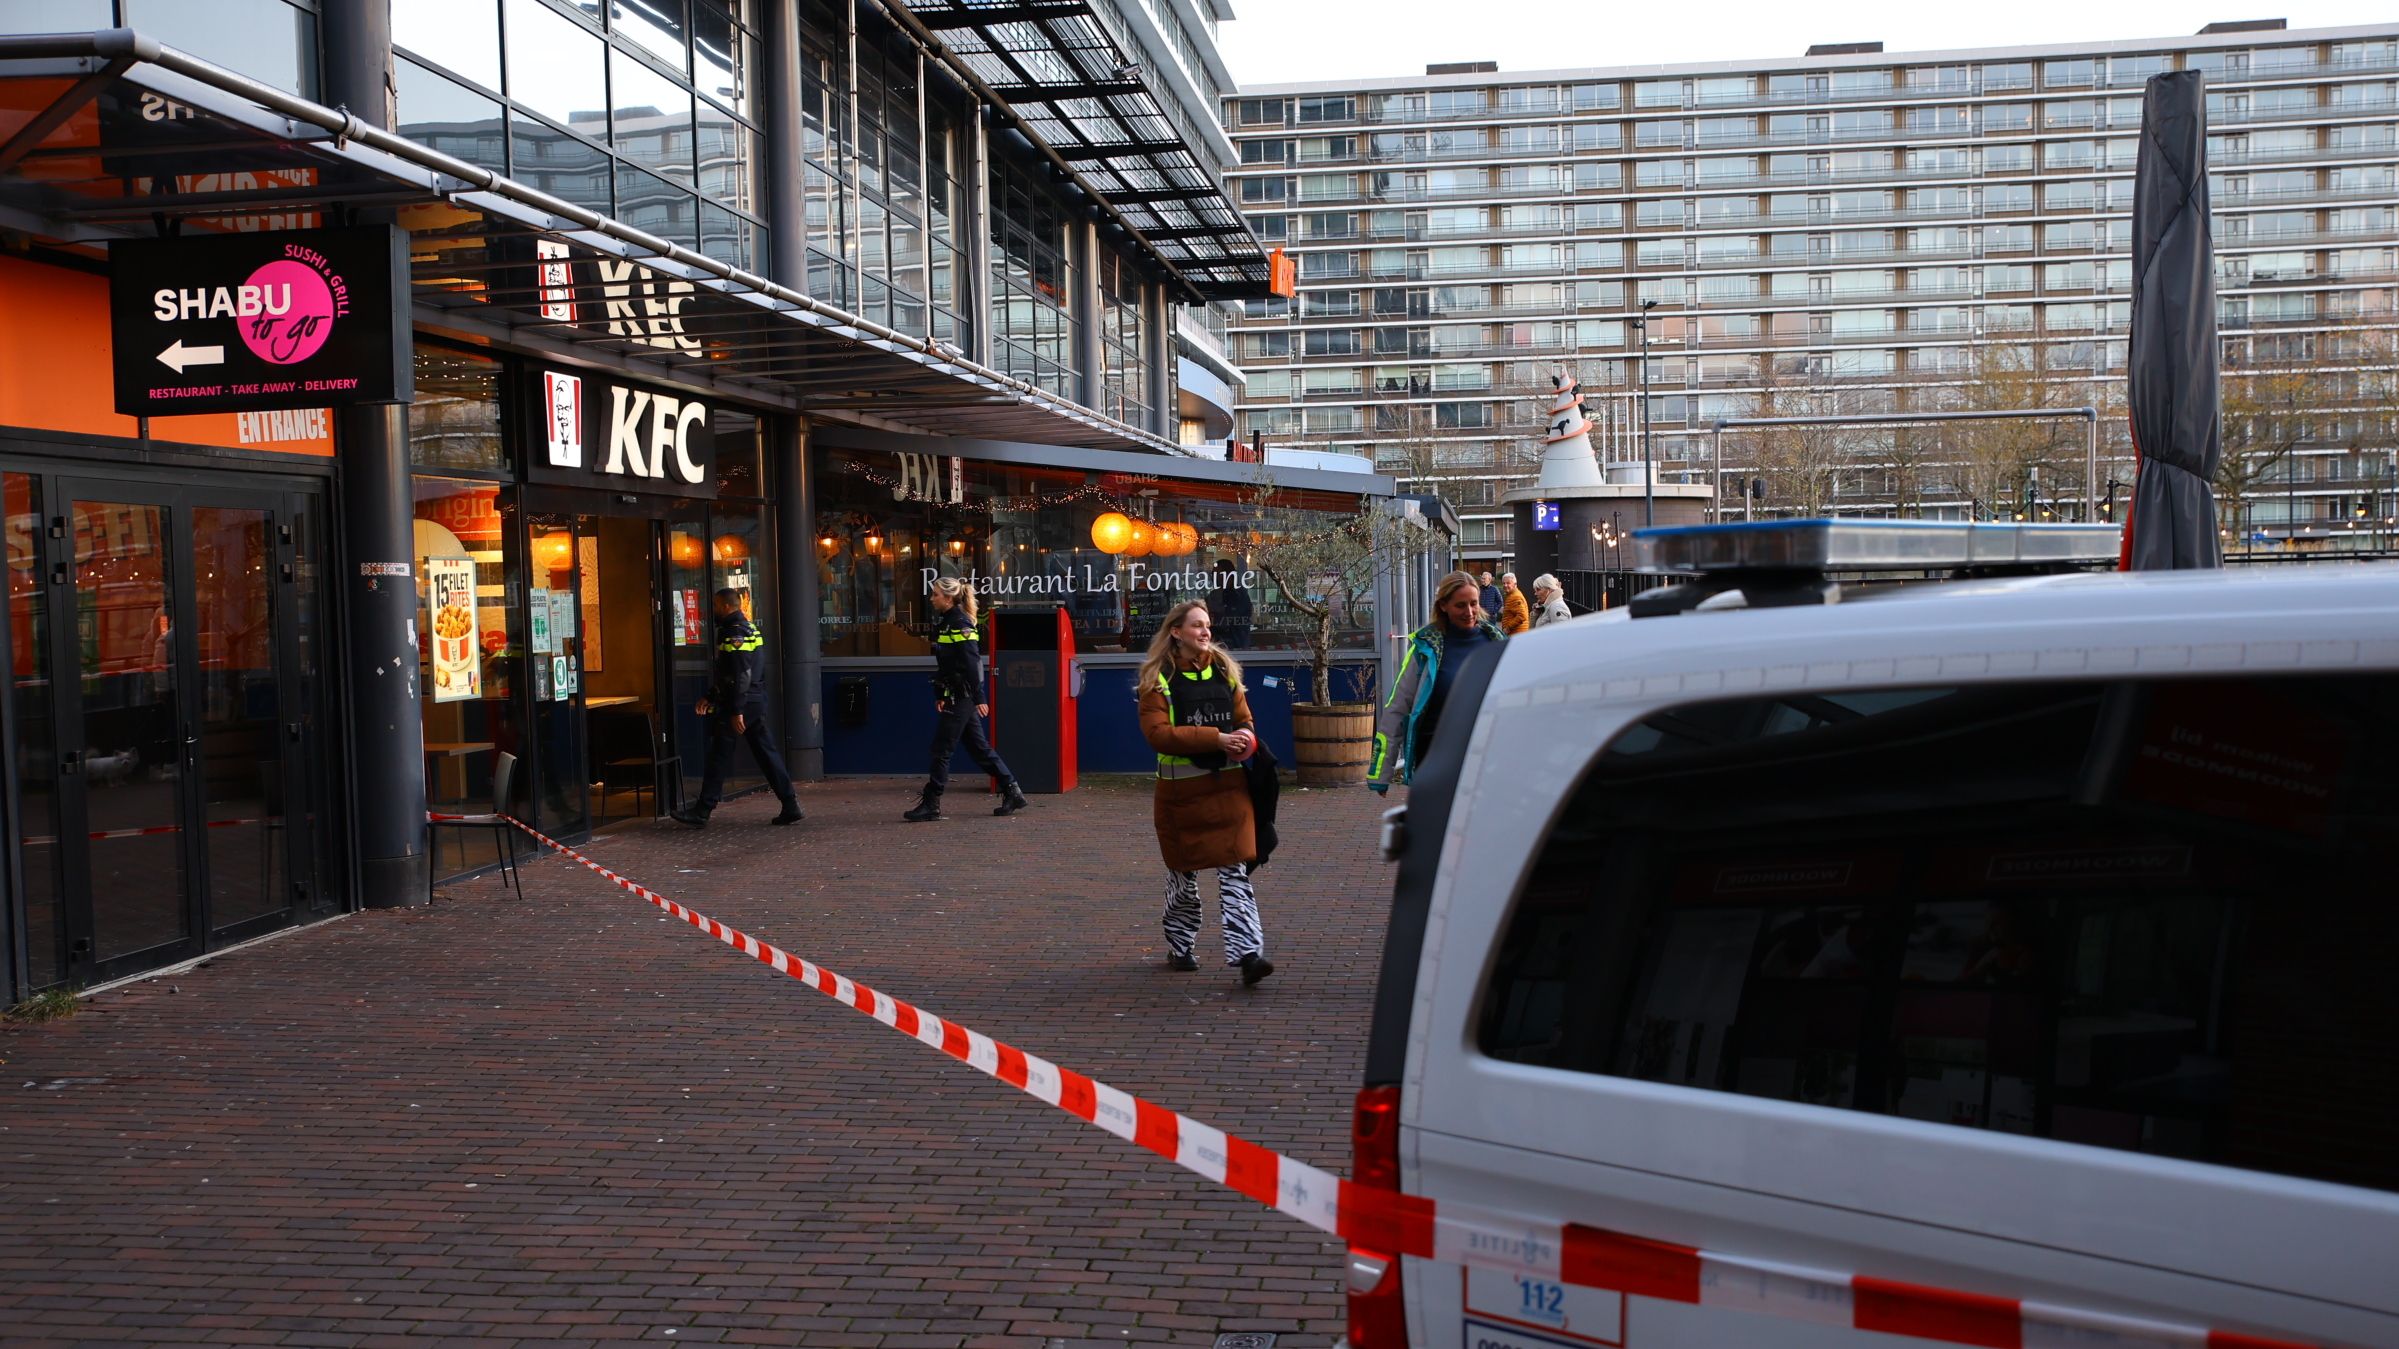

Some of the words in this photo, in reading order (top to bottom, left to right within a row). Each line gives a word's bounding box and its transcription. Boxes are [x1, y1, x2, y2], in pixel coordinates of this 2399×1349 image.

[284, 244, 327, 270] SUSHI
[323, 267, 332, 276] &
[330, 275, 350, 318] GRILL
[154, 283, 292, 322] SHABU
[251, 303, 285, 340] to
[271, 315, 330, 362] go
[149, 385, 222, 399] RESTAURANT
[231, 383, 260, 395] TAKE
[262, 382, 295, 394] AWAY
[305, 378, 358, 392] DELIVERY
[237, 409, 328, 443] ENTRANCE
[605, 385, 706, 484] KFC
[434, 574, 449, 609] 15
[449, 573, 469, 591] FILET
[920, 566, 1077, 596] Rtaurant
[1084, 564, 1121, 593] La
[1130, 563, 1255, 592] Fontaine
[450, 591, 470, 608] BITES
